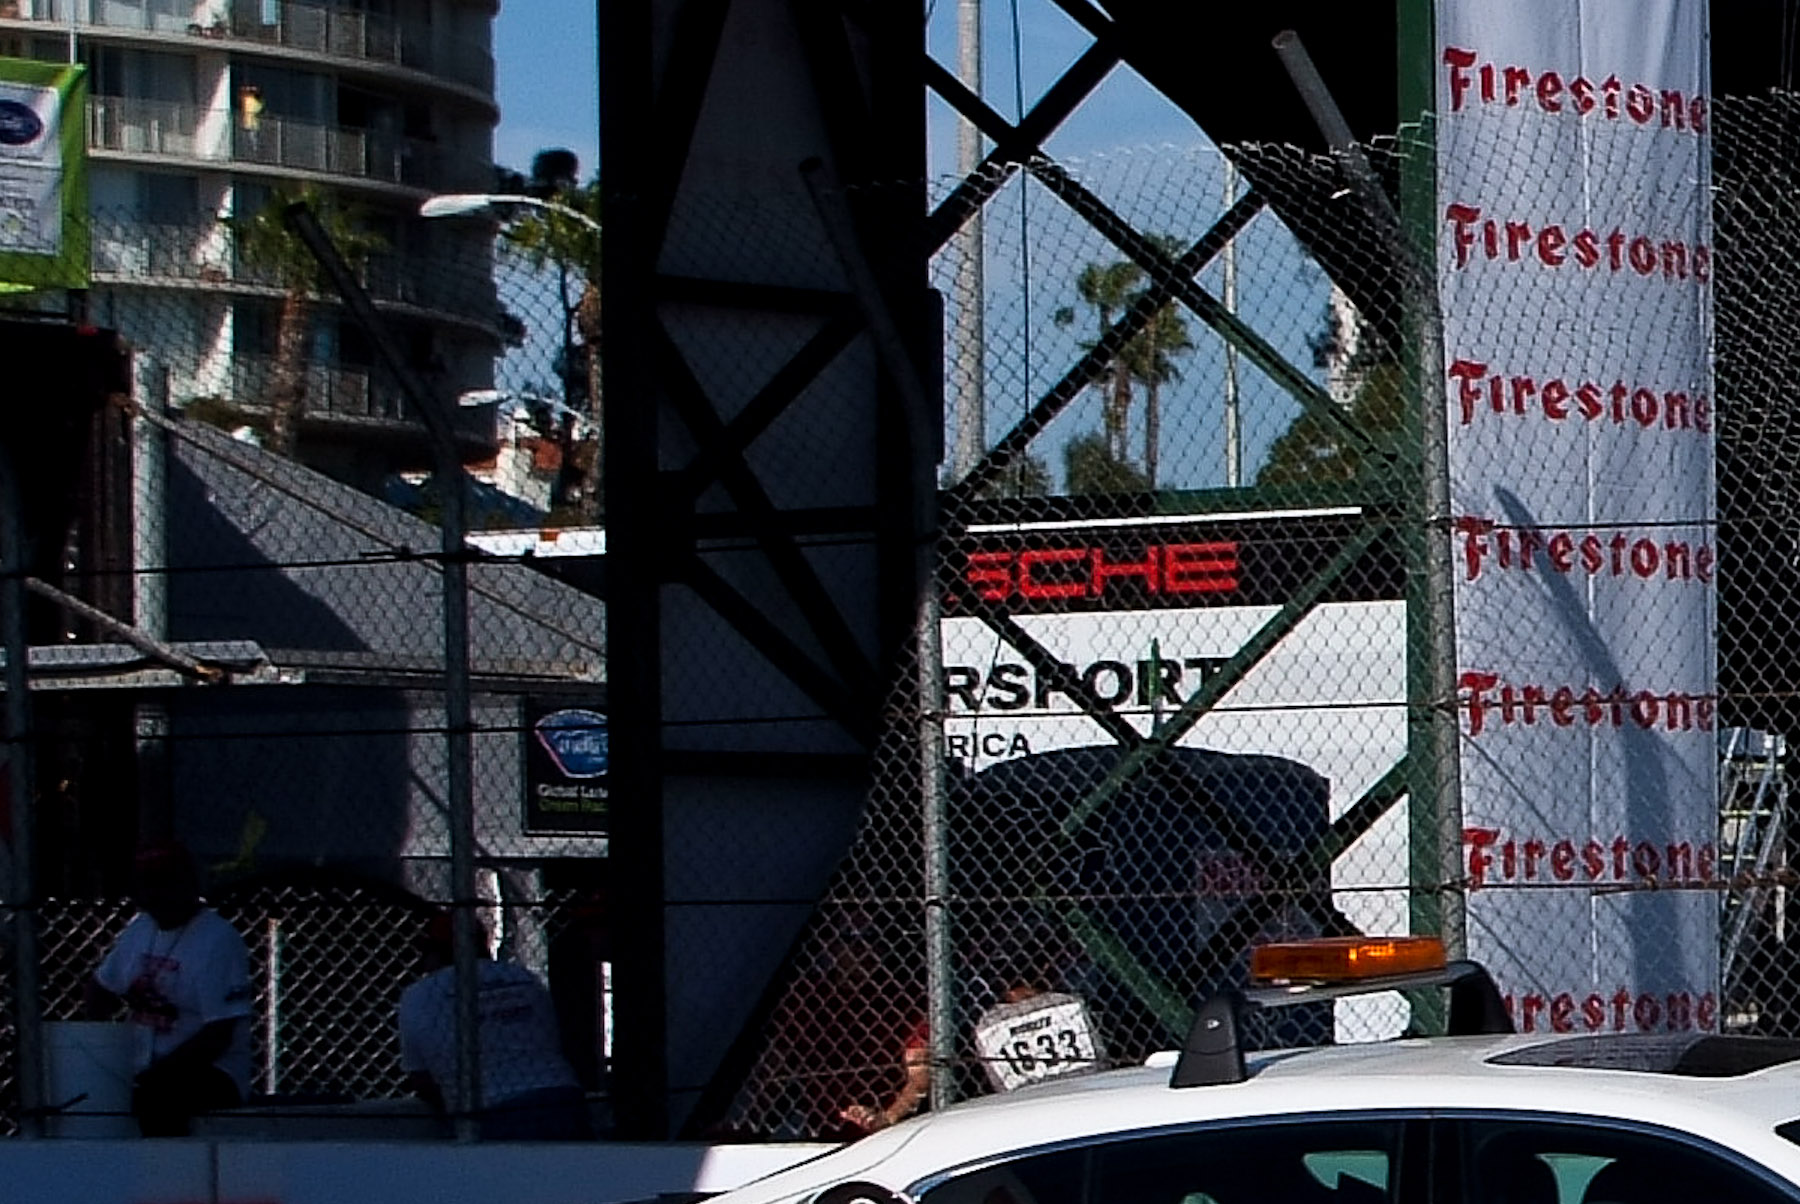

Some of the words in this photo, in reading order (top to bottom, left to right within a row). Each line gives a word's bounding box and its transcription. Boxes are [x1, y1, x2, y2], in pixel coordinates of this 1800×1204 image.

[1443, 47, 1709, 133] Firestone
[1446, 204, 1710, 284] Firestone
[1449, 360, 1713, 433] Firestone
[1456, 516, 1715, 583] Firestone
[1459, 672, 1714, 736] Firestone
[1462, 829, 1716, 892] Firestone
[999, 1029, 1082, 1075] 1633
